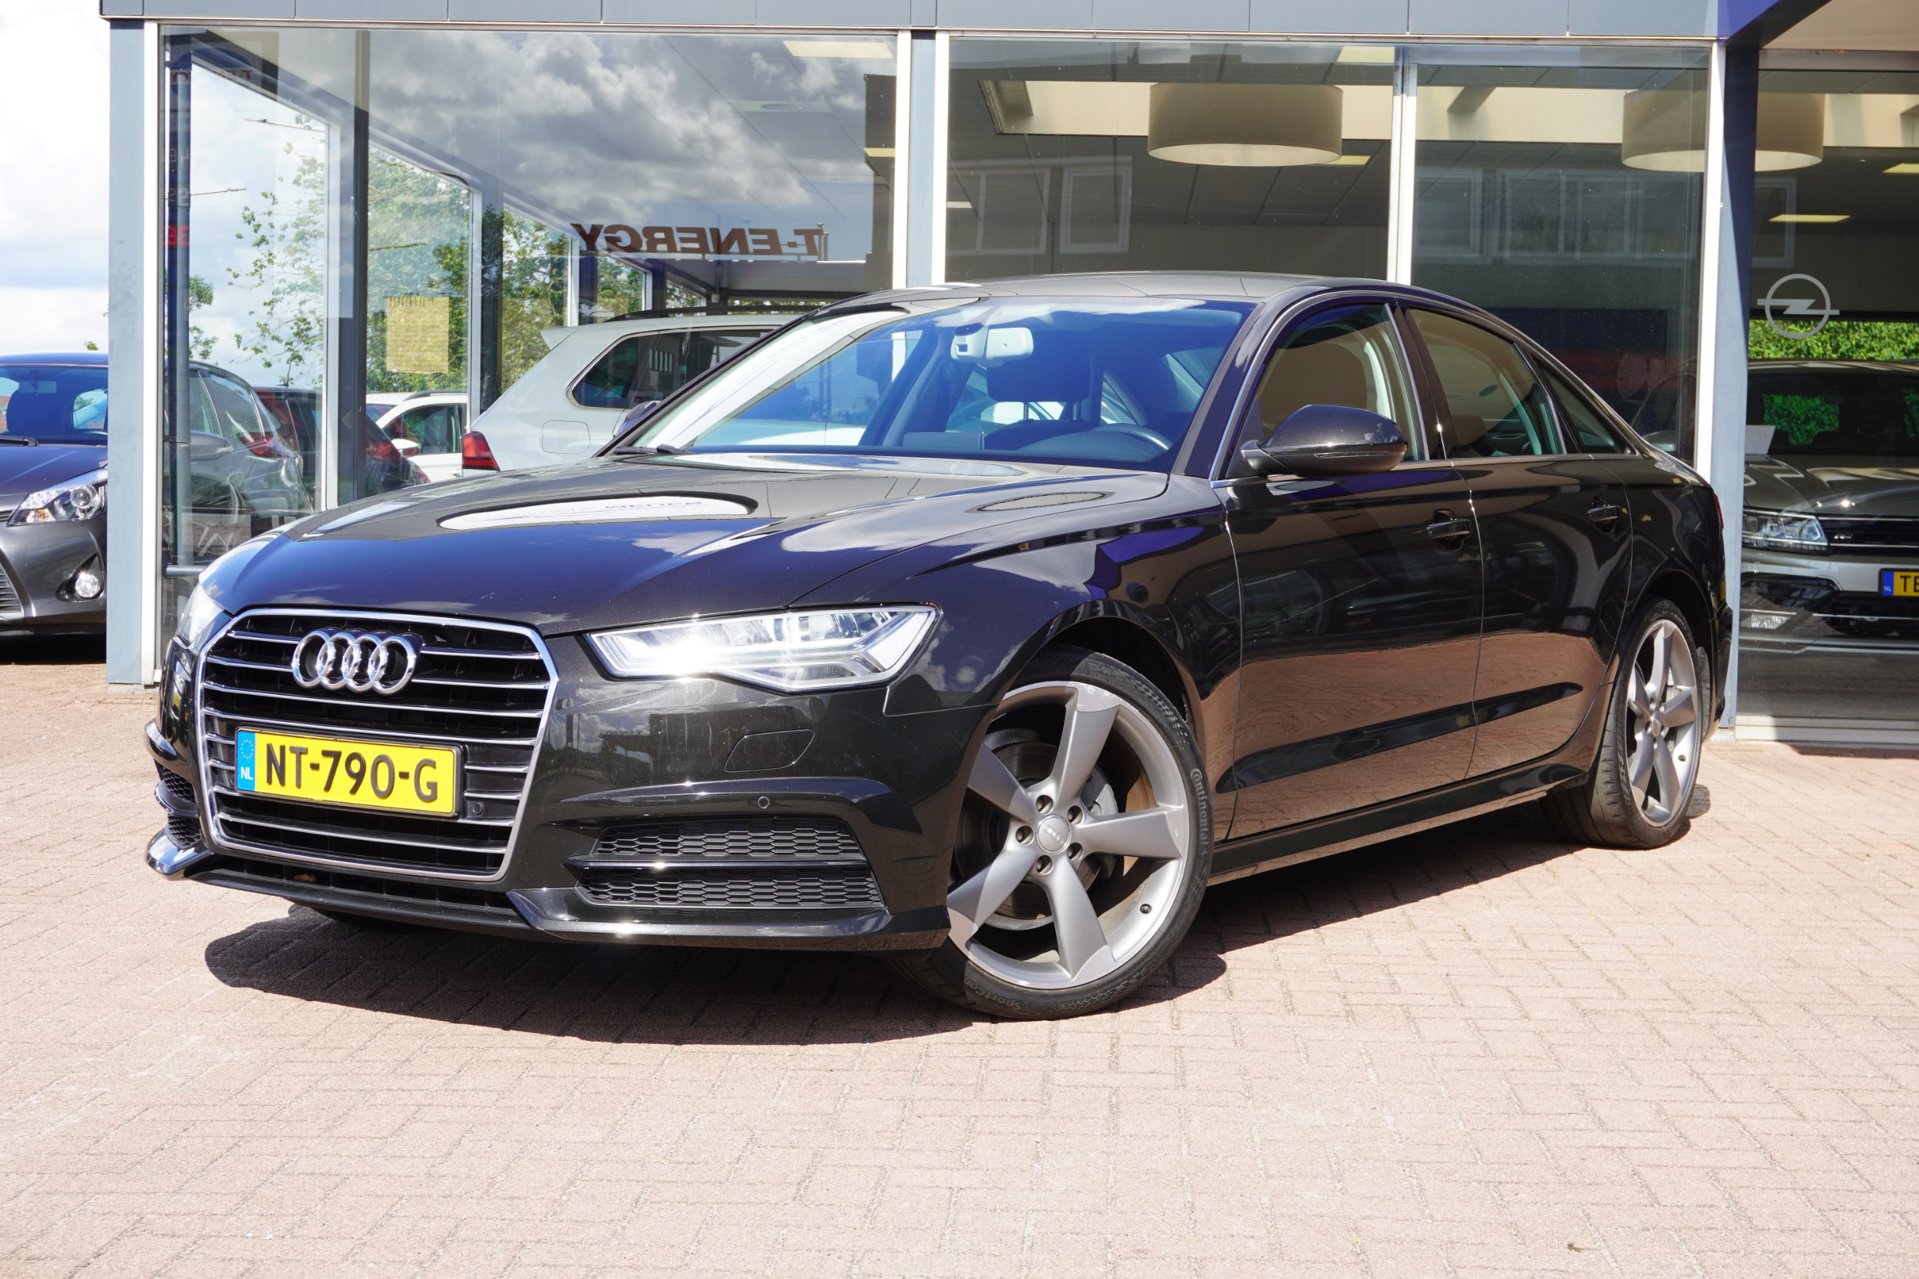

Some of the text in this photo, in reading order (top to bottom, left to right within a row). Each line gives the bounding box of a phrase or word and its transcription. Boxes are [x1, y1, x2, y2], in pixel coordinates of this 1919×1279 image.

[240, 766, 253, 781] NL
[266, 743, 438, 803] NT-790-G
[1190, 767, 1208, 844] Continental
